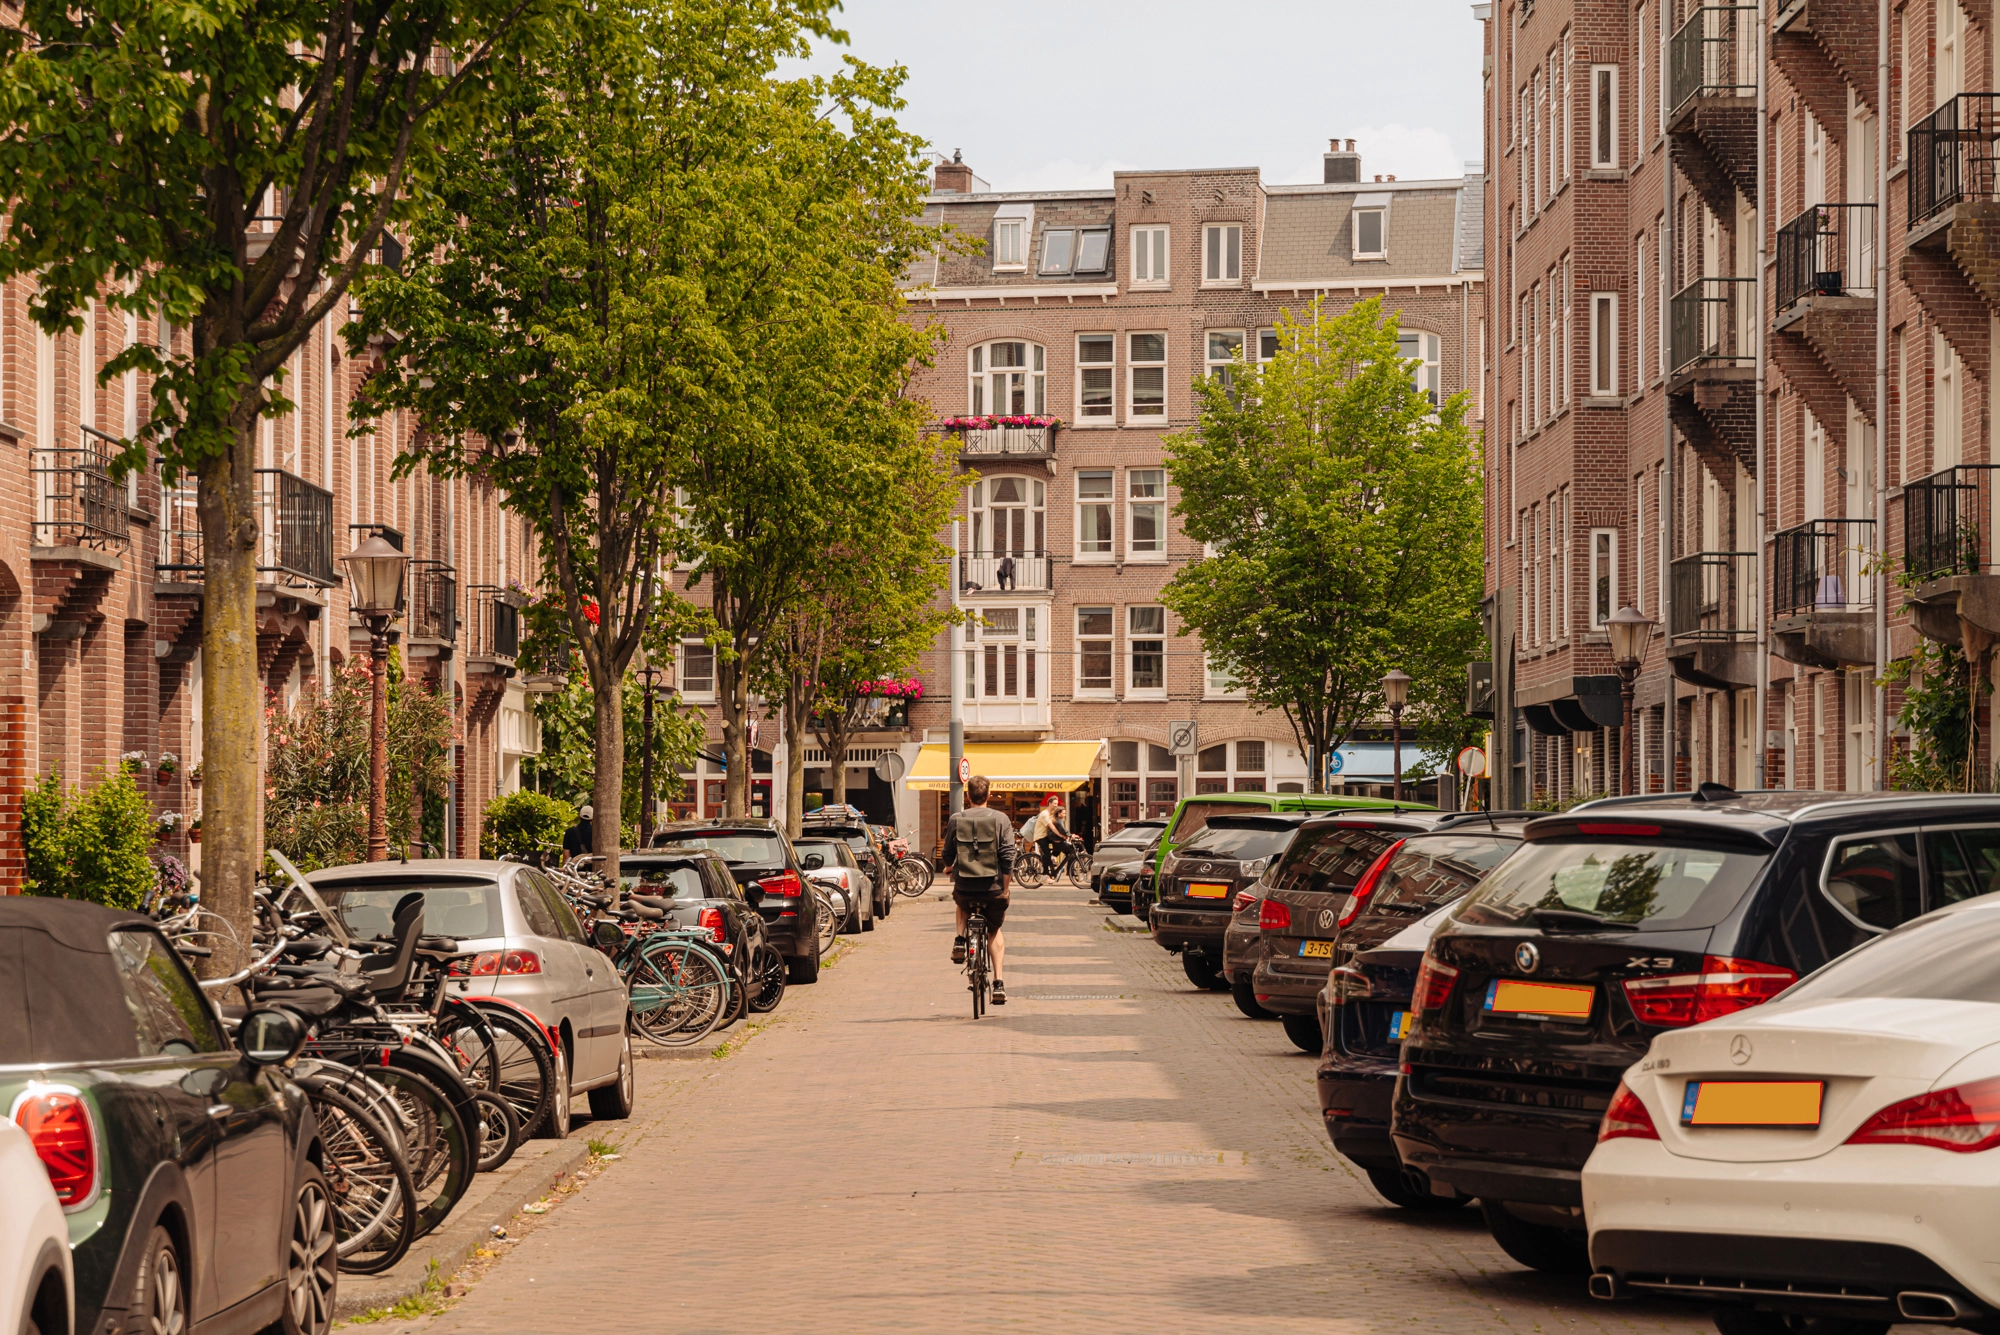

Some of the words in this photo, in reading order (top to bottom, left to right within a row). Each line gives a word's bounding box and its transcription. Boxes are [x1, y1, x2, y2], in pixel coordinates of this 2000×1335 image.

[962, 765, 968, 775] 30
[1307, 943, 1333, 955] 3-TS
[1625, 957, 1674, 969] X3
[1684, 1105, 1694, 1114] NL
